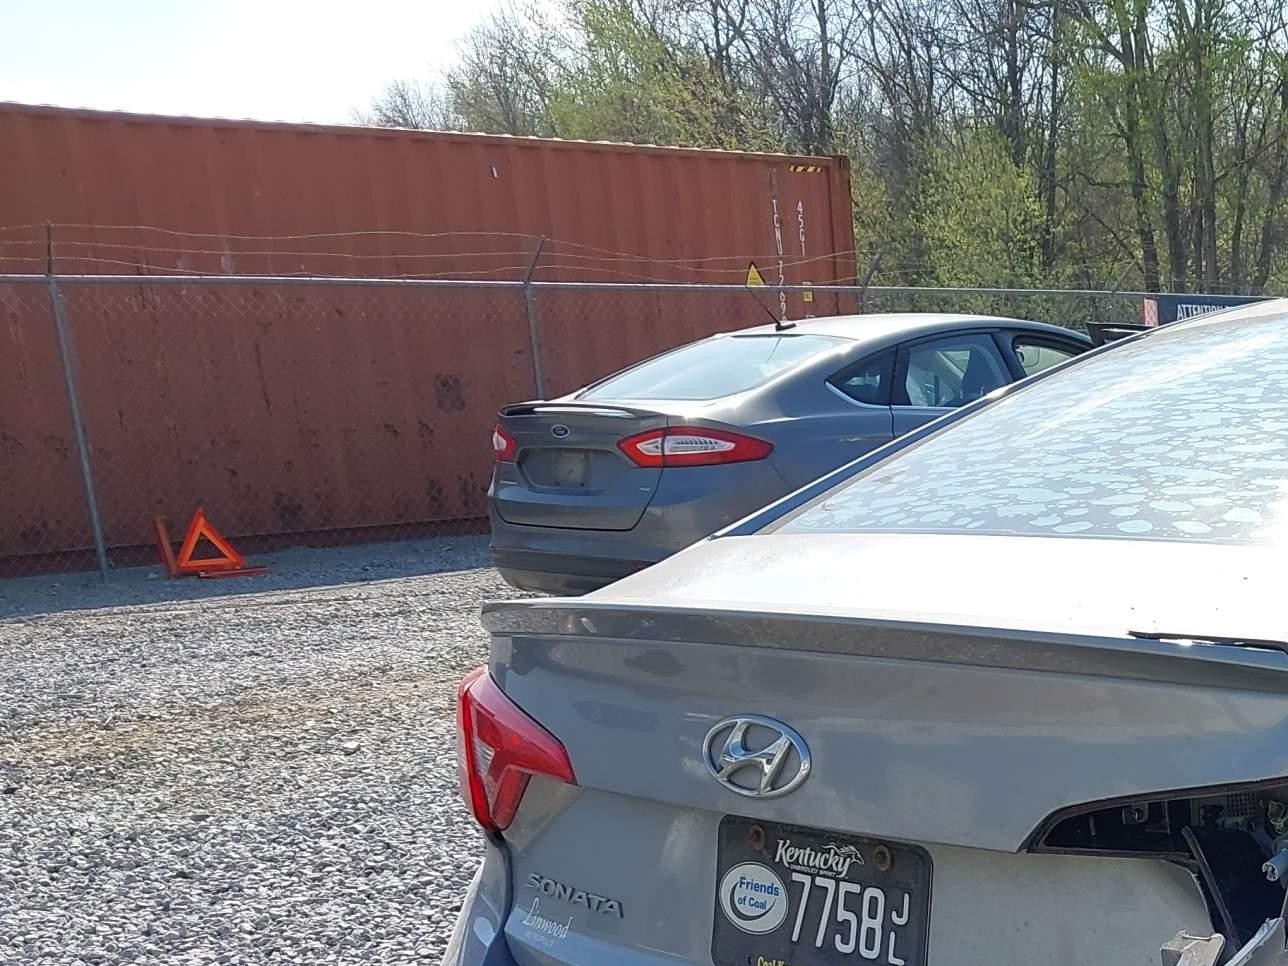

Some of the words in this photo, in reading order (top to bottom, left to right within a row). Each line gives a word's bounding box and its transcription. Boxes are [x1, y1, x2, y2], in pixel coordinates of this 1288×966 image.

[796, 200, 806, 256] 45G1
[774, 839, 851, 878] Kentucky
[526, 872, 624, 918] SONATA
[737, 895, 747, 906] of
[748, 896, 767, 910] Coal
[739, 876, 780, 897] Friends
[521, 897, 574, 940] Linwood
[791, 871, 885, 960] 7758
[891, 892, 910, 926] J
[887, 930, 905, 966] L
